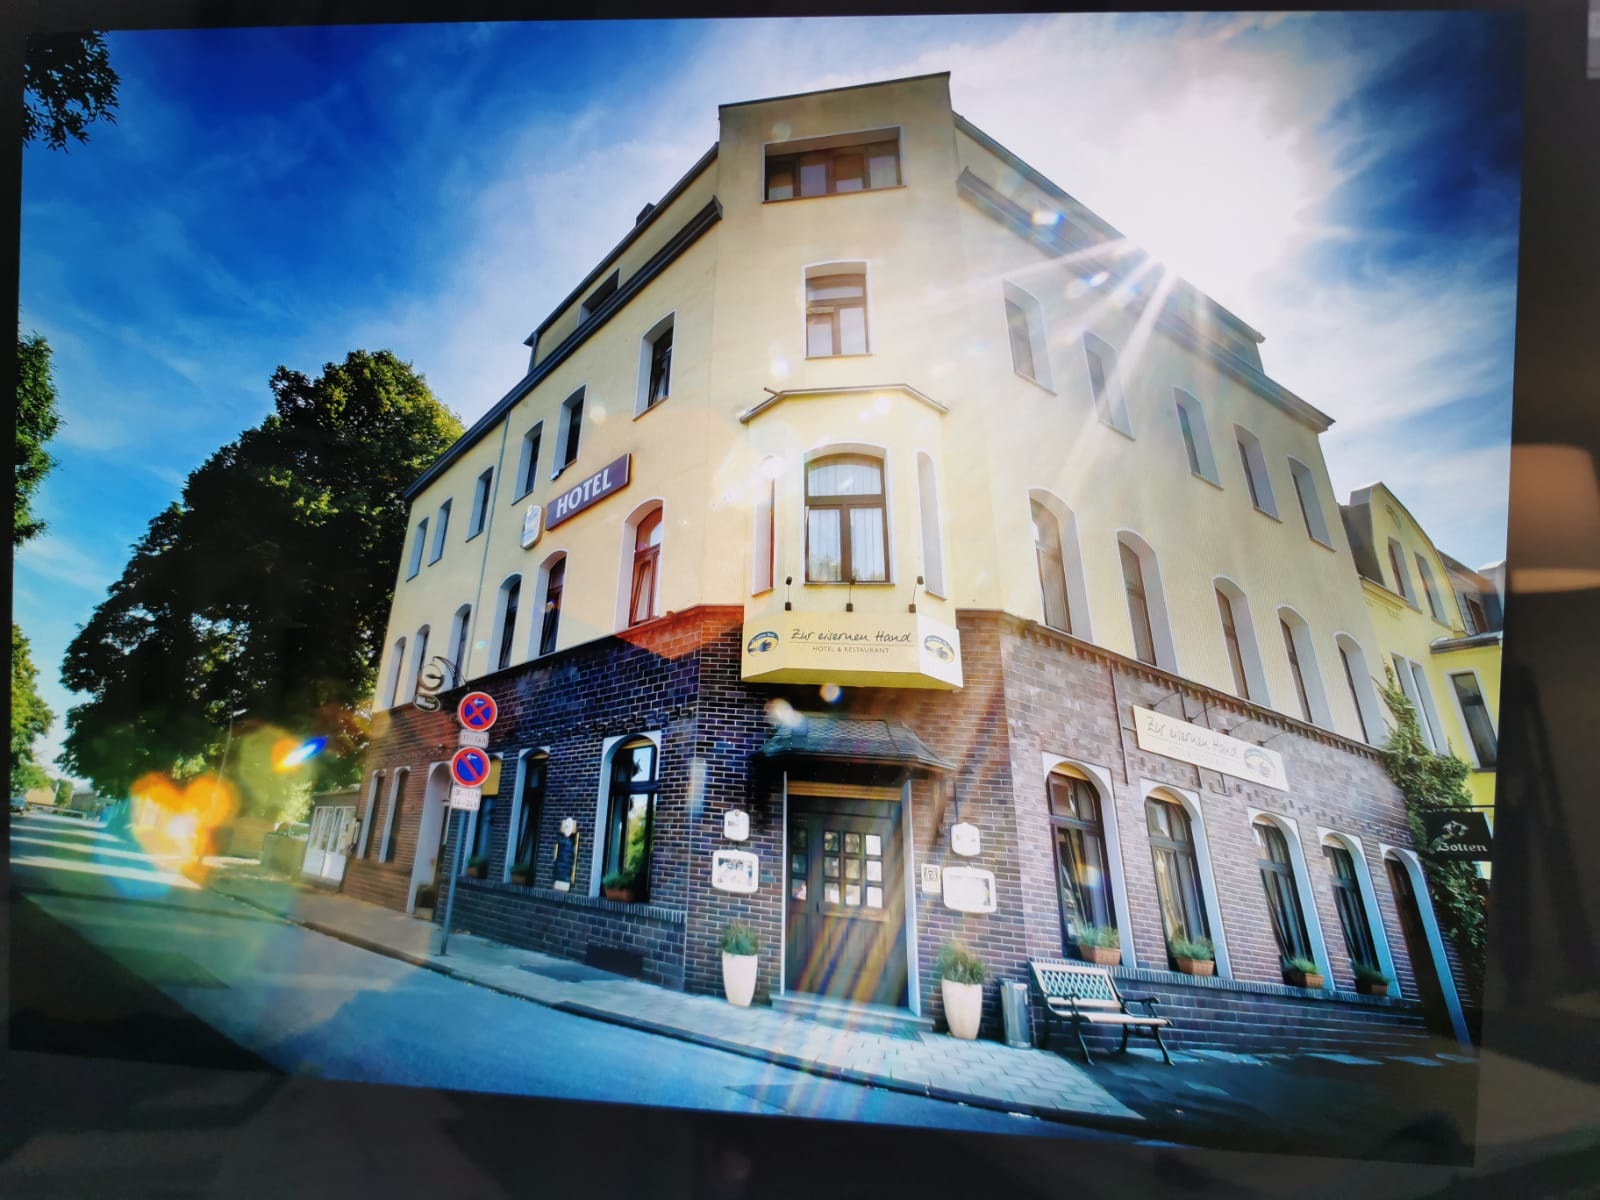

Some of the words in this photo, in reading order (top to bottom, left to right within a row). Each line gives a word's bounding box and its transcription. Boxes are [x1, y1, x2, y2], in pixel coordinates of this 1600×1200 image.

[556, 468, 612, 518] HOTEL
[791, 628, 816, 641] Zur
[818, 629, 870, 643] eisernen
[875, 630, 913, 643] Hand
[812, 645, 835, 653] HOTEL
[844, 646, 890, 654] RESTAURANT
[1147, 716, 1166, 737] Zur
